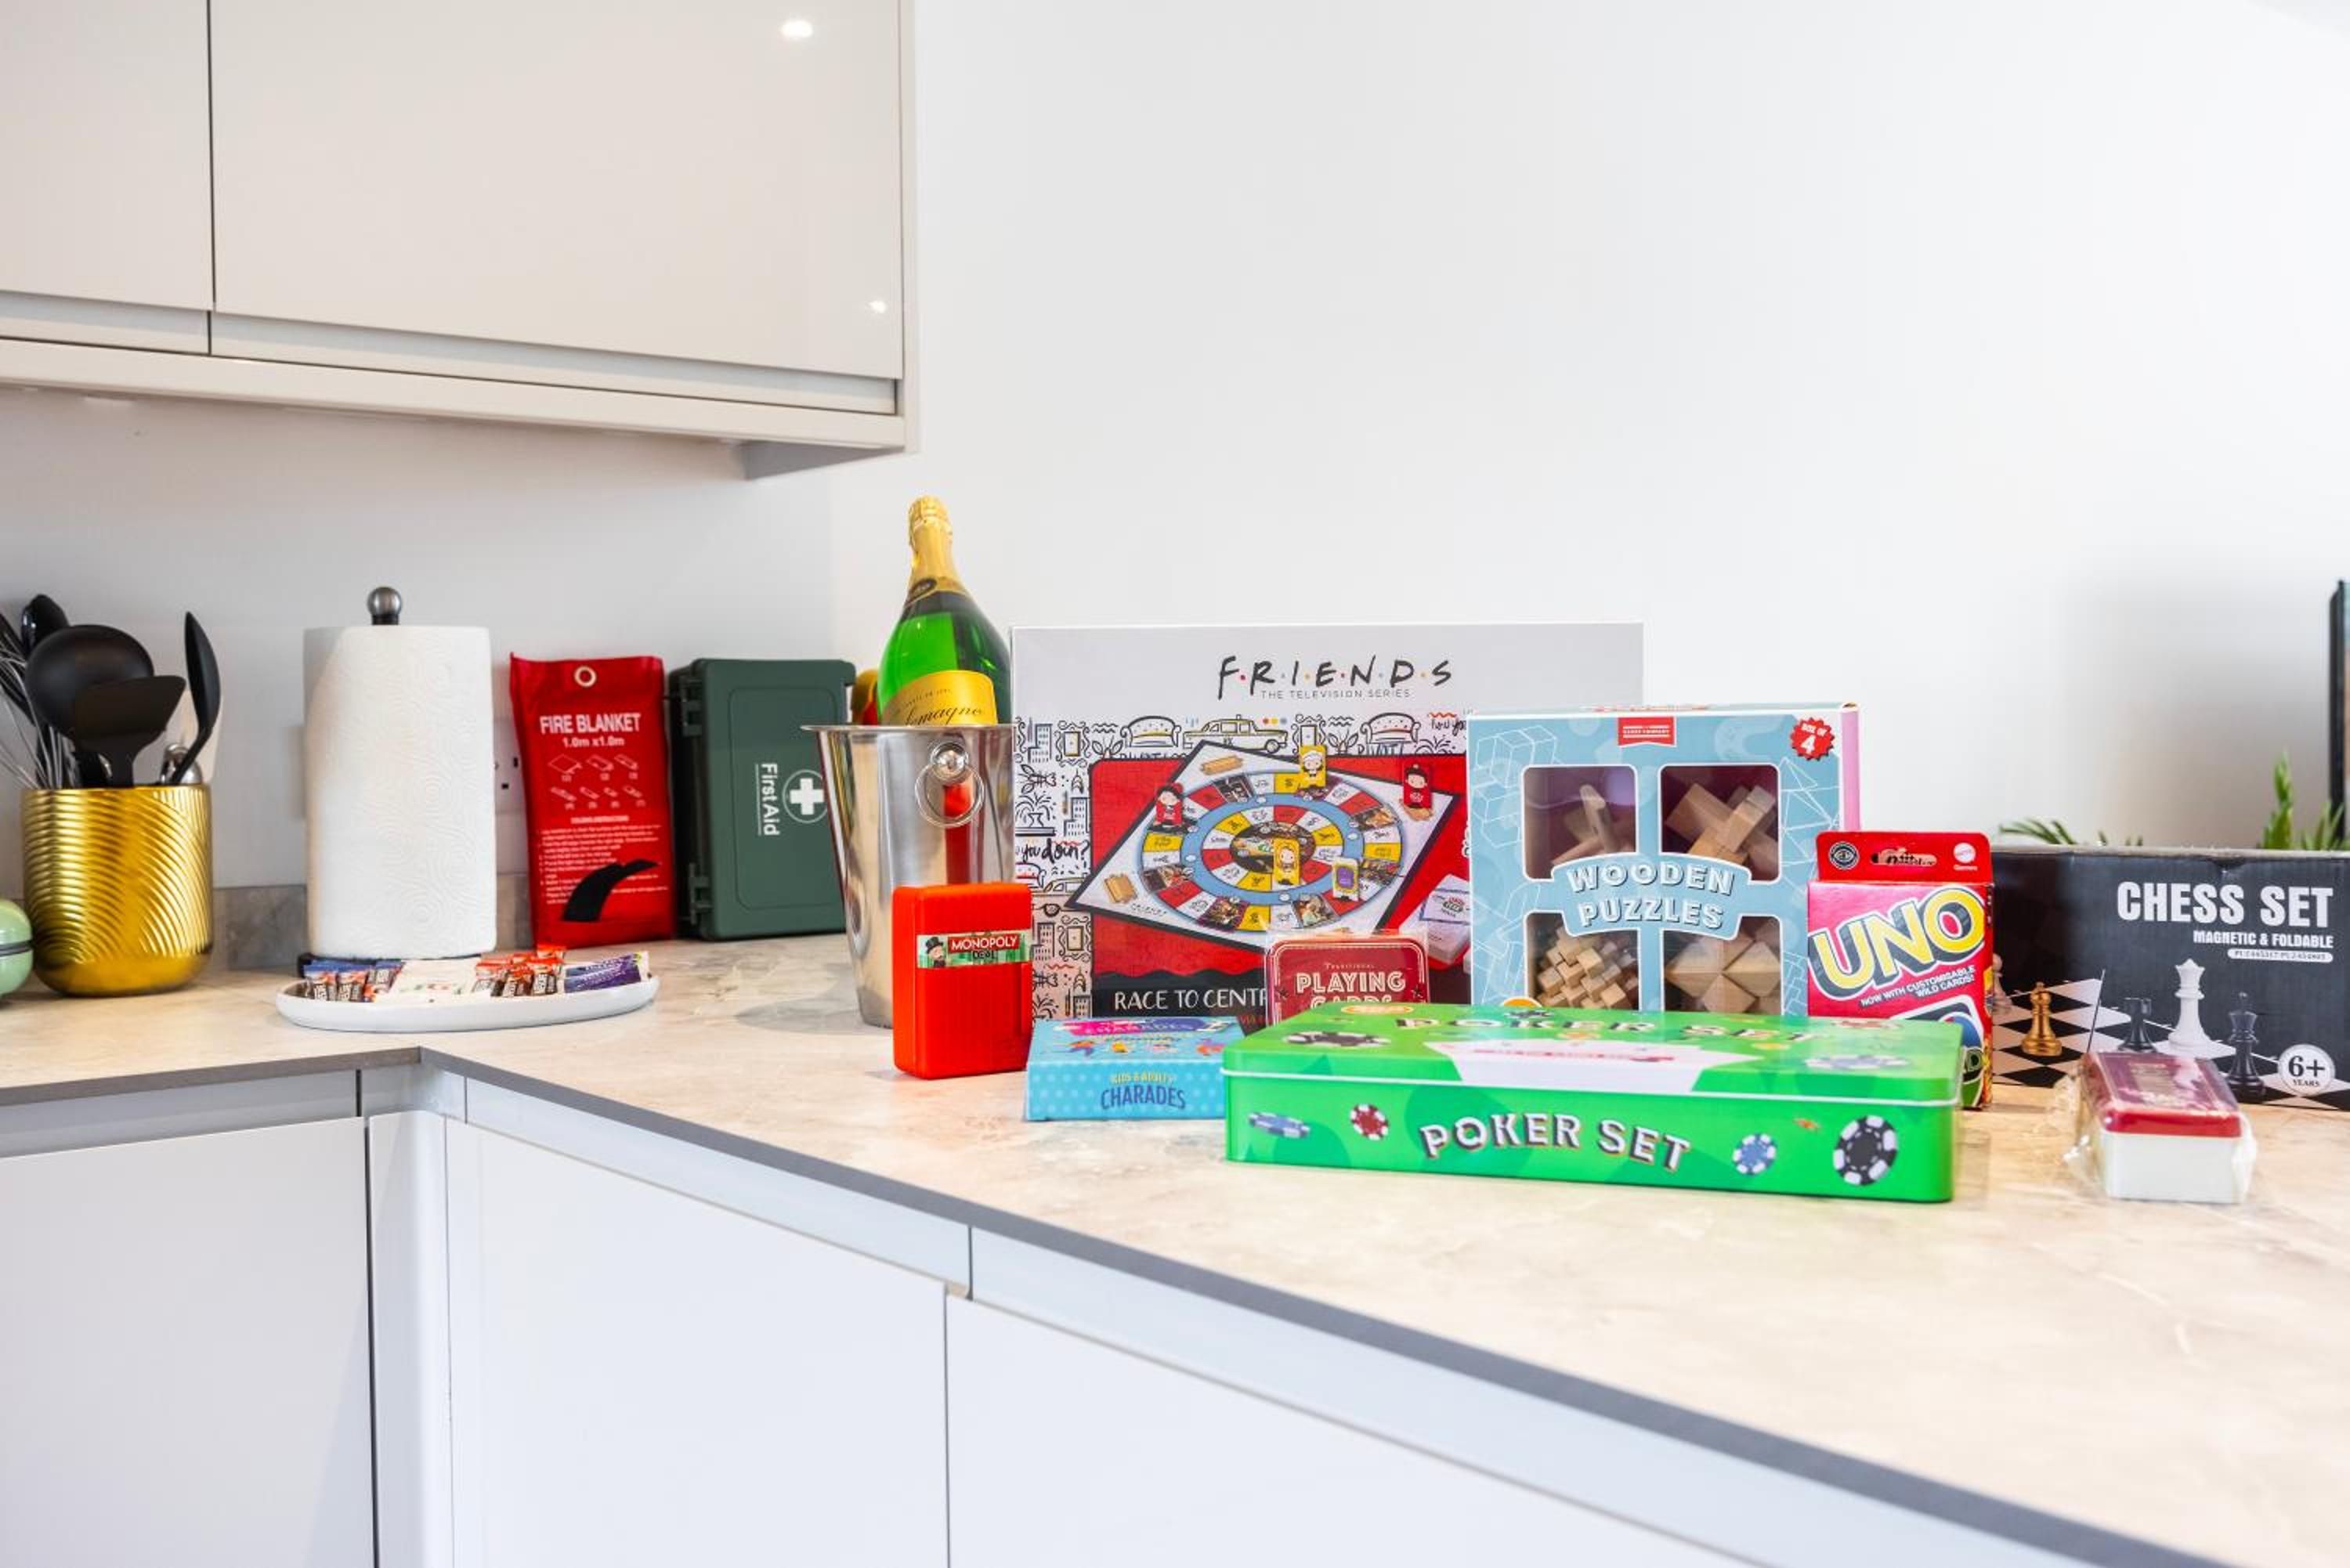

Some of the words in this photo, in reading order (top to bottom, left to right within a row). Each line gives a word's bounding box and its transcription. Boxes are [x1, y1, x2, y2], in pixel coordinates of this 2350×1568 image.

[1260, 690, 1284, 699] THE
[1289, 689, 1363, 699] TELEVISION
[1368, 688, 1411, 699] SERIES
[539, 714, 573, 735] FIRE
[576, 713, 641, 733] BLANKET
[562, 736, 590, 748] 1.0m
[1800, 735, 1815, 754] 4
[761, 763, 778, 802] First
[763, 804, 780, 836] Aid
[1567, 861, 1734, 897] WOODEN
[1578, 897, 1724, 930] PUZZLES
[2117, 881, 2244, 925] CHESS
[2260, 885, 2334, 927] SET
[950, 936, 1018, 951] MONOPOLY
[1809, 885, 1985, 1000] UNO
[2193, 930, 2257, 946] MAGNETIC
[2260, 932, 2269, 946] &
[2272, 934, 2334, 948] FOLDABLE
[1296, 971, 1406, 993] PLAYING
[1916, 985, 1940, 998] WILD
[1942, 975, 1975, 992] CARDS!
[1115, 990, 1169, 1010] RACE
[1173, 989, 1199, 1009] TO
[1860, 995, 1883, 1006] NOW
[1883, 988, 1906, 999] WITH
[2288, 1055, 2326, 1078] 6+
[1101, 1084, 1185, 1110] CHARADES
[1419, 1113, 1581, 1160] POKER
[1598, 1118, 1690, 1172] SET
